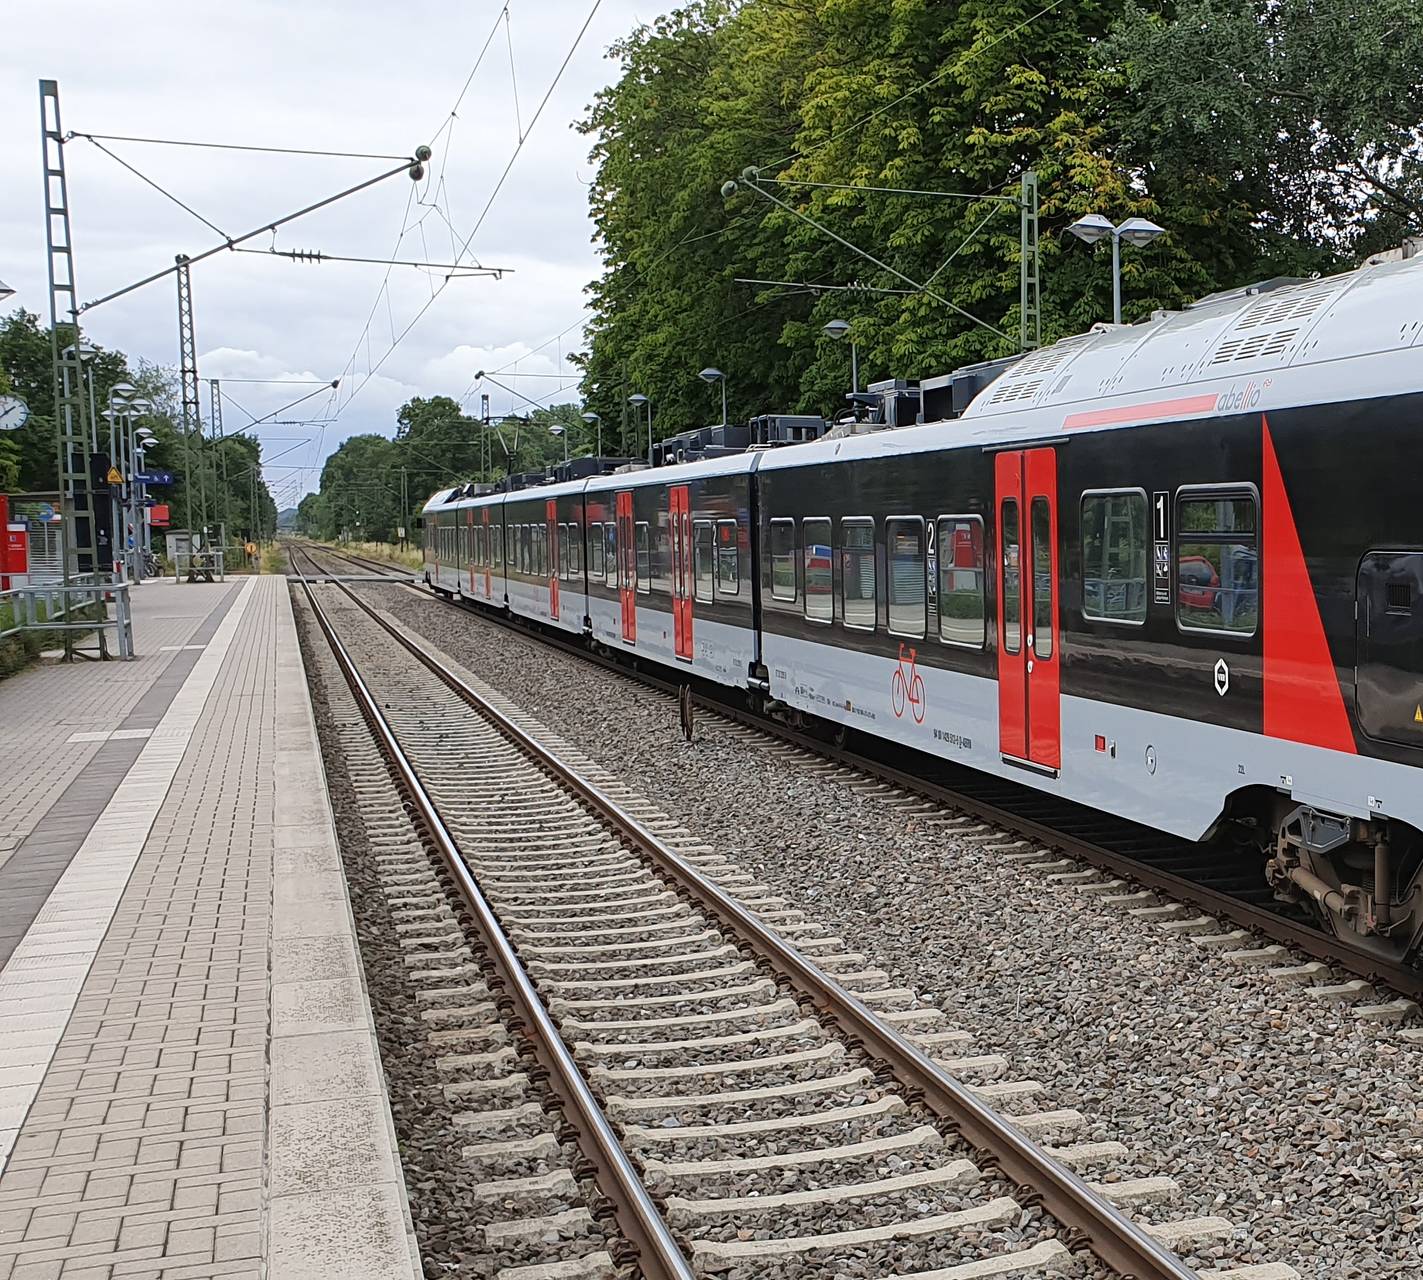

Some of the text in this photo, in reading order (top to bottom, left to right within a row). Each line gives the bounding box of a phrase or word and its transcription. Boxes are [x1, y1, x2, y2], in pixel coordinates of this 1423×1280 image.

[1217, 381, 1261, 412] abellio
[1156, 495, 1164, 539] 1
[927, 522, 935, 554] 2
